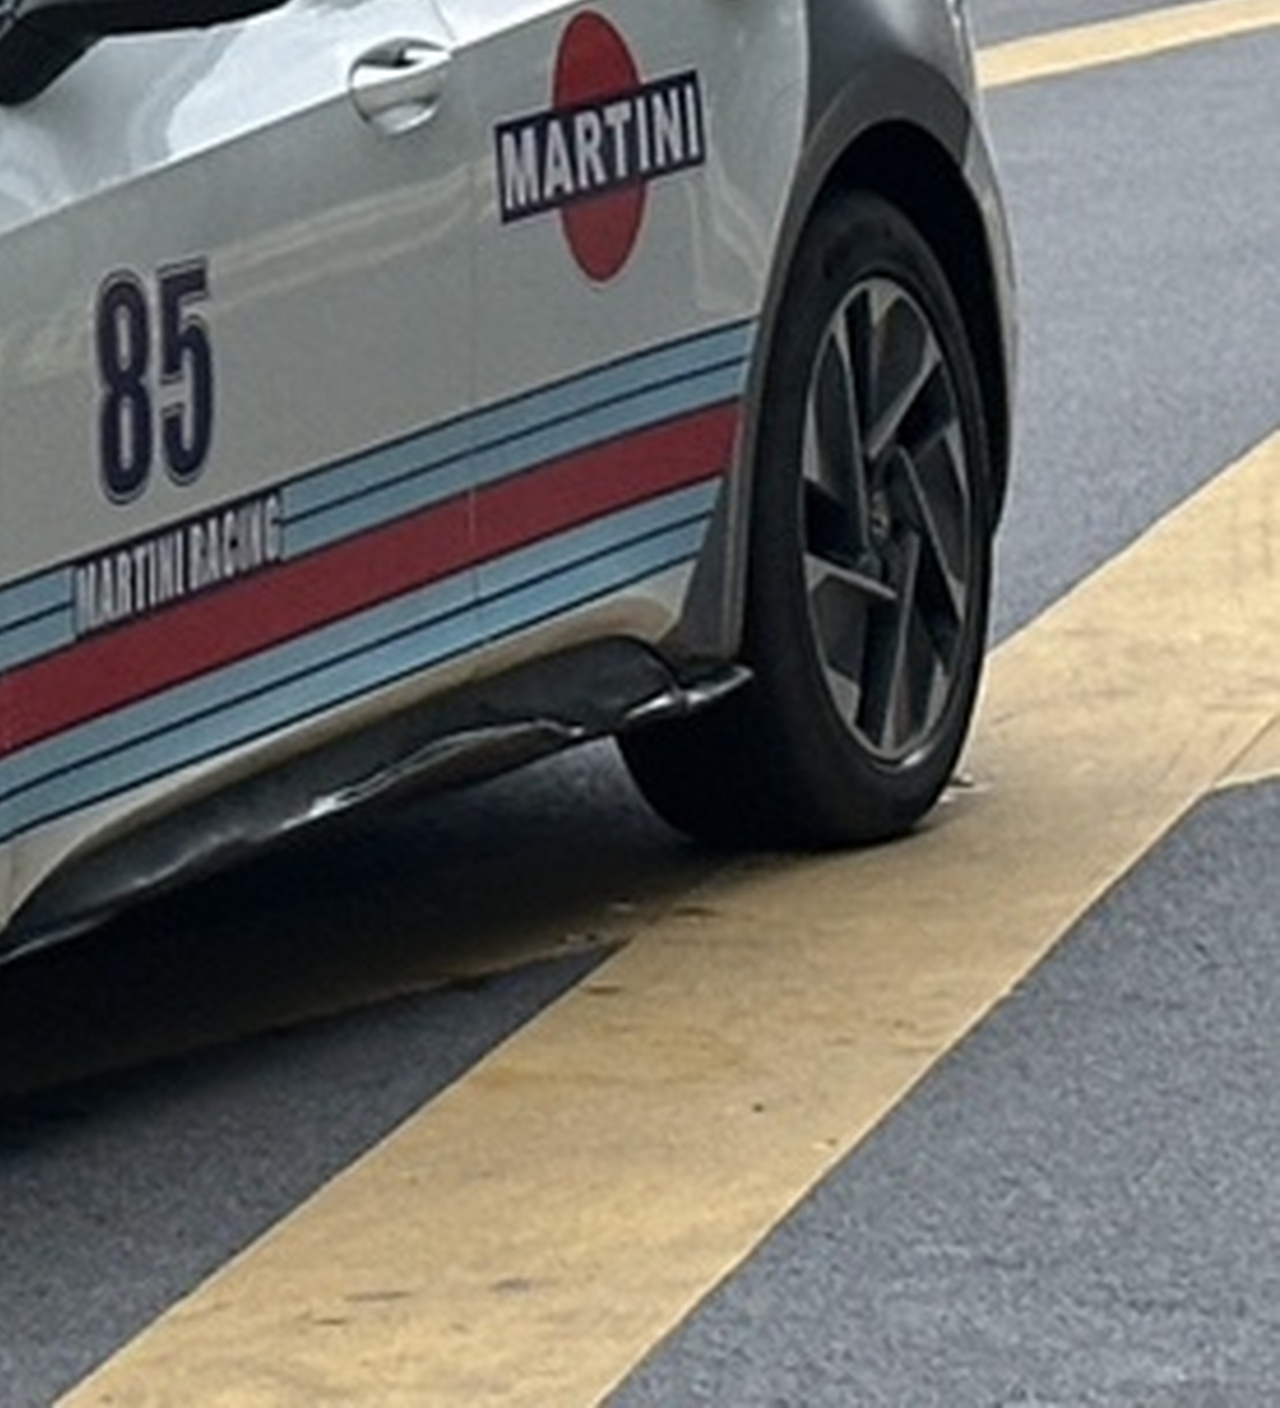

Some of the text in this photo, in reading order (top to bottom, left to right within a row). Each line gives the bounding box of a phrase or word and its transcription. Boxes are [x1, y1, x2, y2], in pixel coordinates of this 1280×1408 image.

[500, 84, 701, 210] MARTINI
[95, 254, 214, 506] 85
[75, 495, 282, 636] MARTINI RACING
